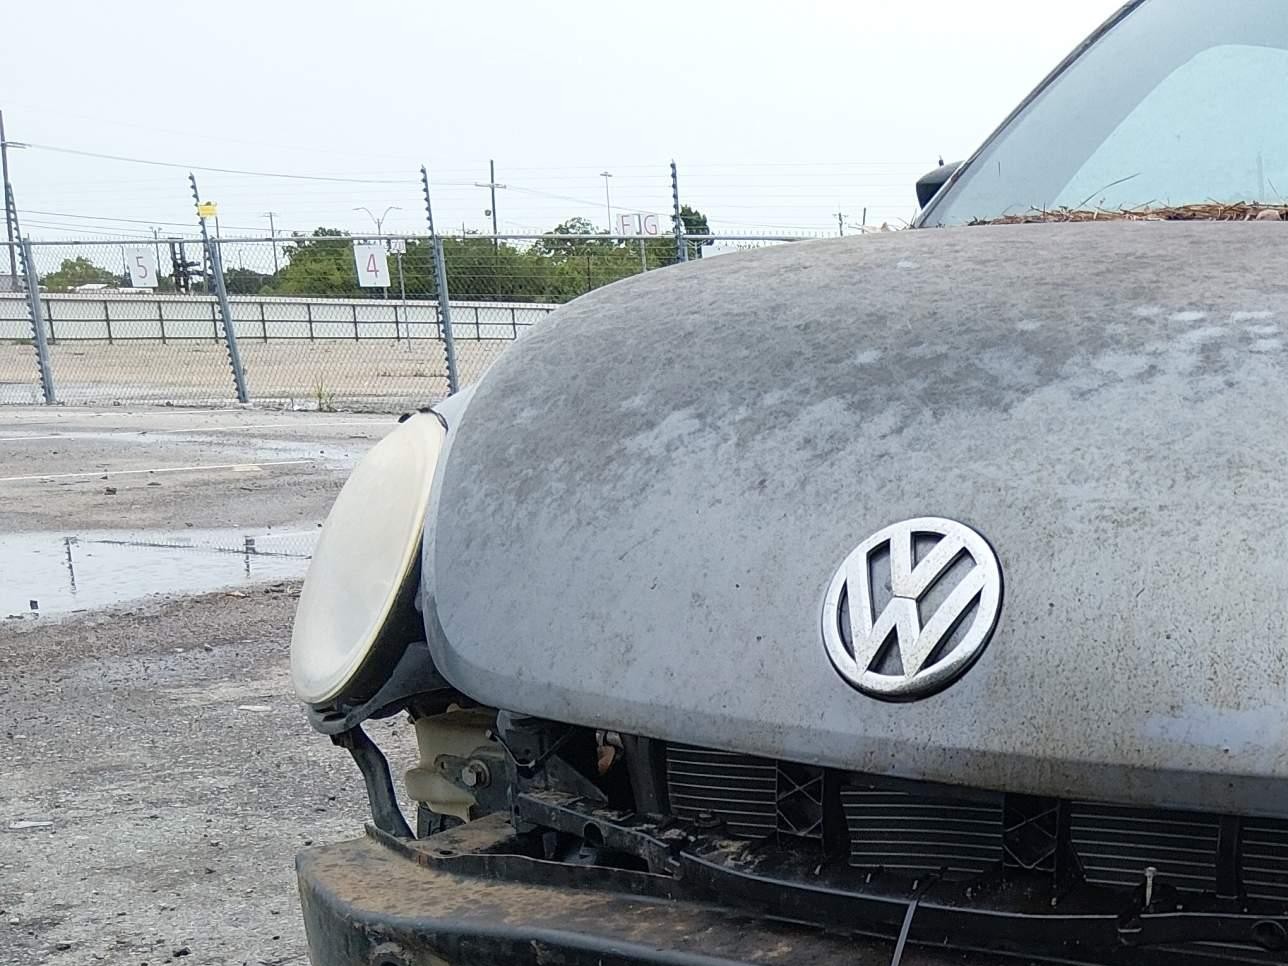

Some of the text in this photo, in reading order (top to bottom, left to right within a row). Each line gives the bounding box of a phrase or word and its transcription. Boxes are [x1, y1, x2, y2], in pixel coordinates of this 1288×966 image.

[135, 256, 148, 279] 5
[366, 253, 380, 278] 4
[836, 523, 992, 686] VW
